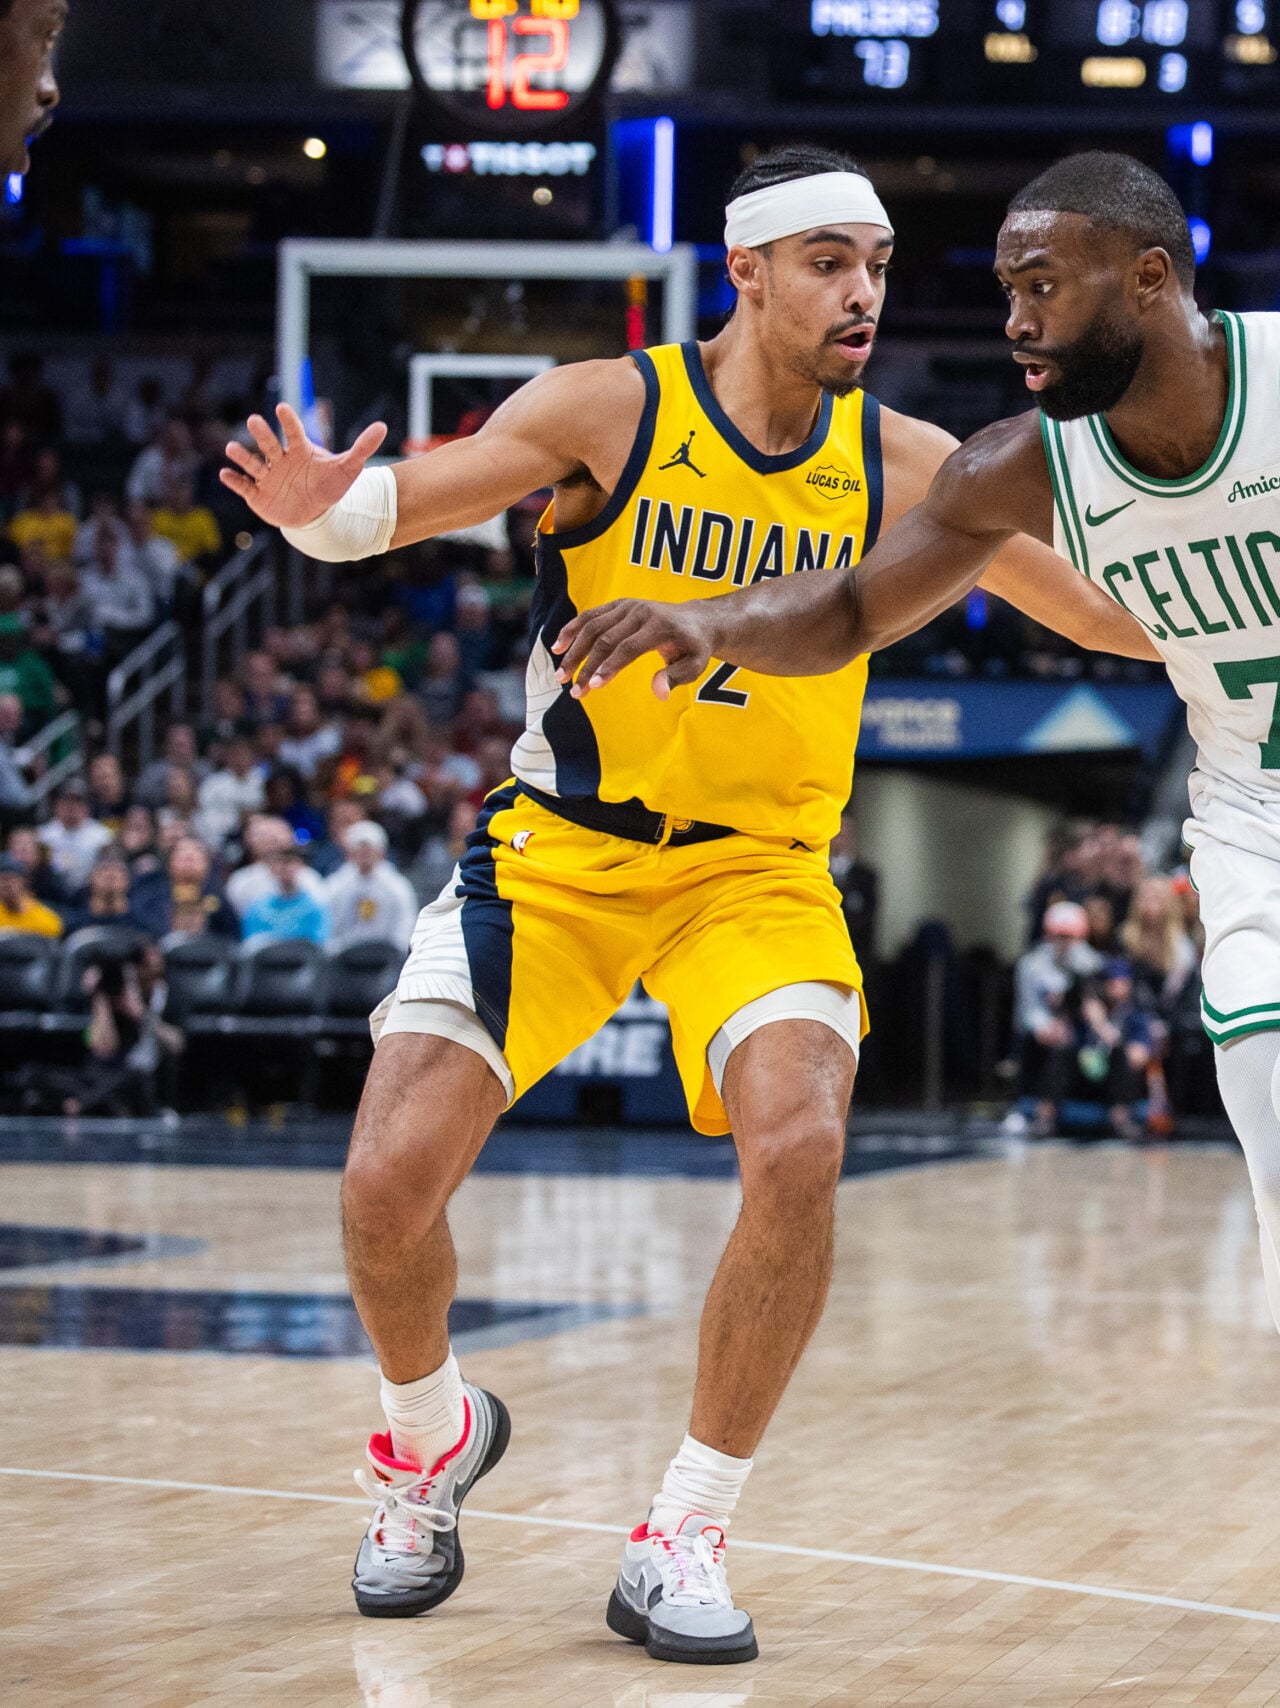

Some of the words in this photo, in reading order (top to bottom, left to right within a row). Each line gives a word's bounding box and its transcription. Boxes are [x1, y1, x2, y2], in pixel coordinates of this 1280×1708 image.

[486, 15, 570, 110] 12
[806, 472, 839, 489] LUCAS
[842, 479, 861, 491] OIL
